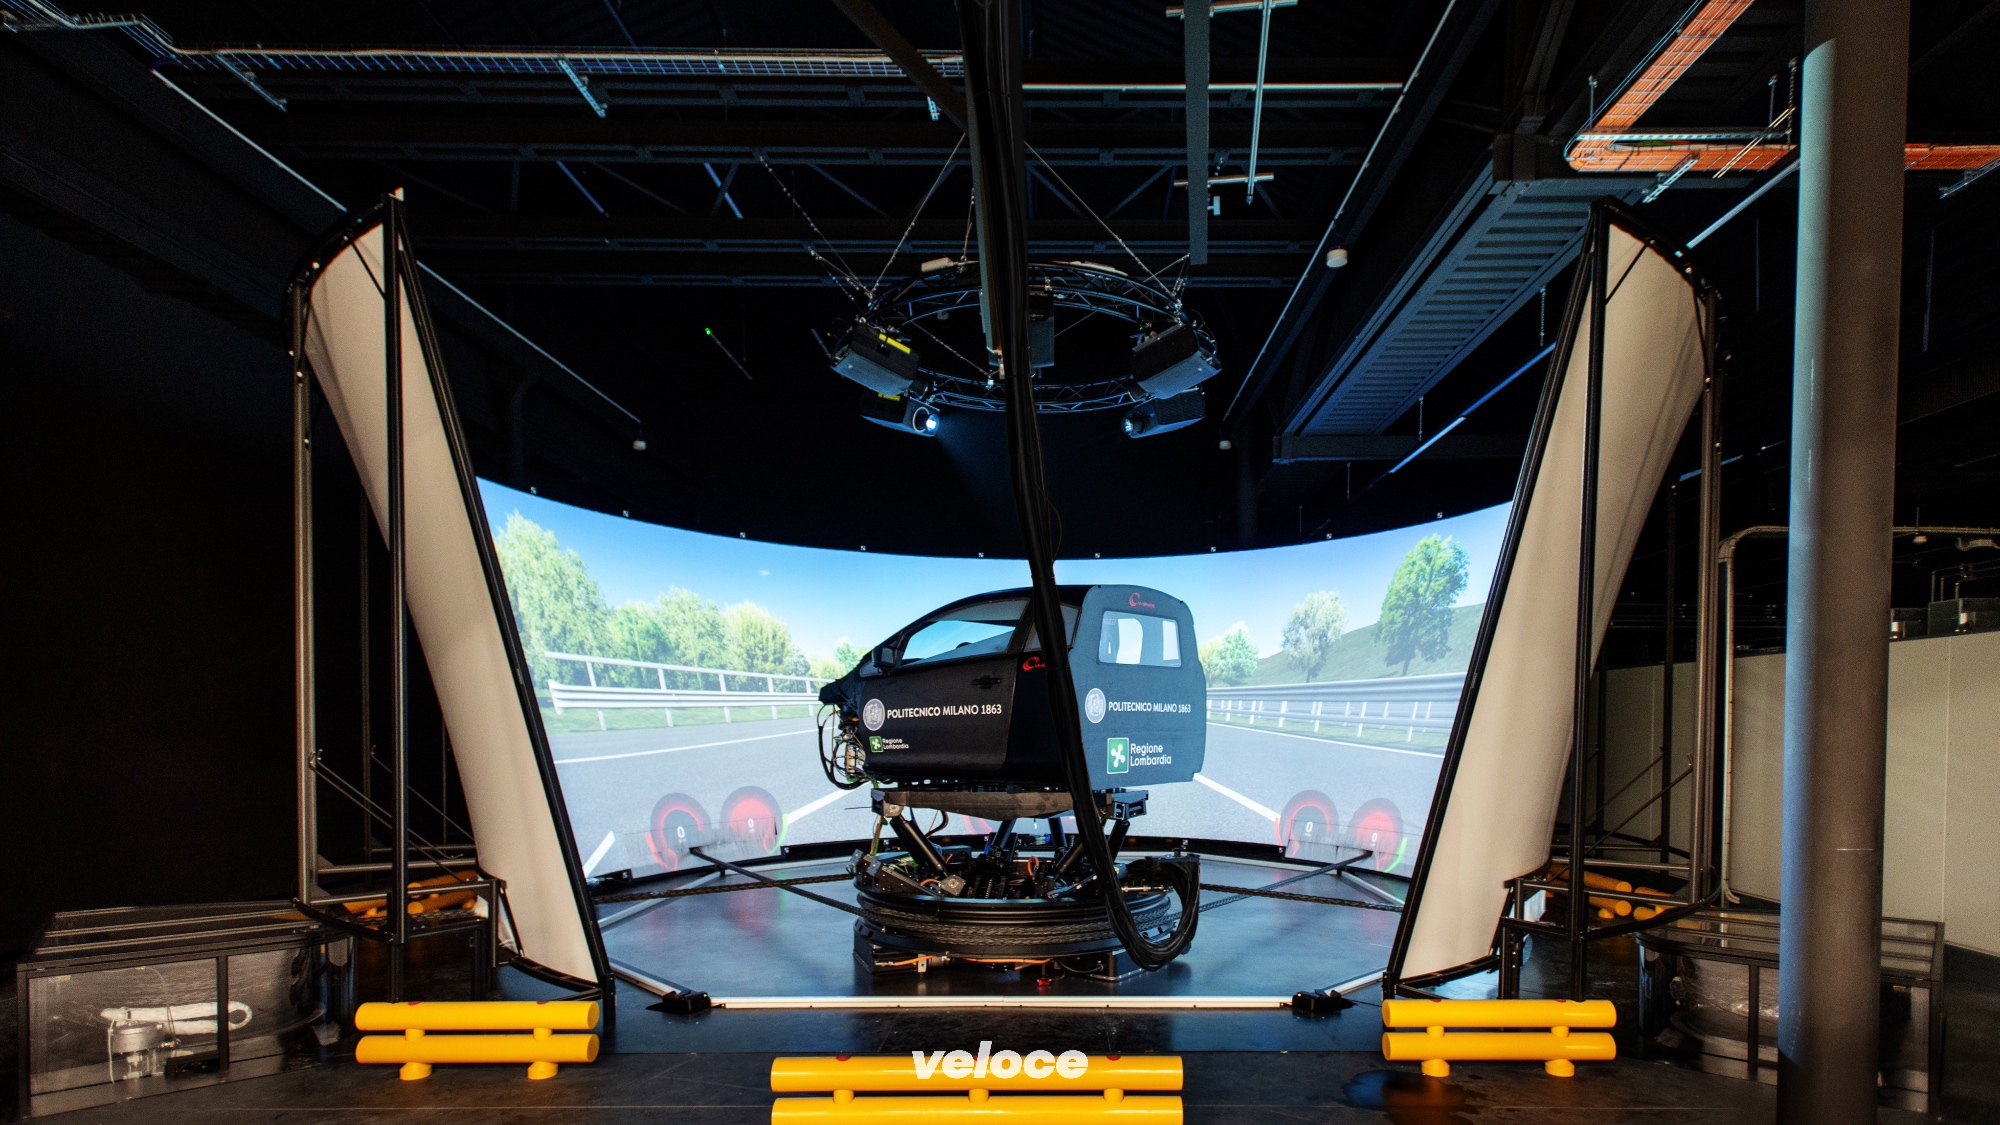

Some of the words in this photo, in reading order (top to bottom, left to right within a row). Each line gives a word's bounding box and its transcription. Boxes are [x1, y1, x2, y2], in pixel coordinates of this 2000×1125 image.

[887, 706, 940, 719] POLITECNICO
[942, 704, 979, 716] MILANO
[981, 704, 1002, 715] 1863
[1108, 701, 1152, 712] POLITECNICO
[1153, 703, 1177, 713] MILANO
[1178, 704, 1191, 713] 1863
[1130, 743, 1163, 756] Regione
[1130, 755, 1172, 767] Lombardia
[747, 818, 754, 828] 0
[1305, 821, 1313, 833] 0
[677, 825, 685, 838] 0
[1371, 832, 1378, 842] 0
